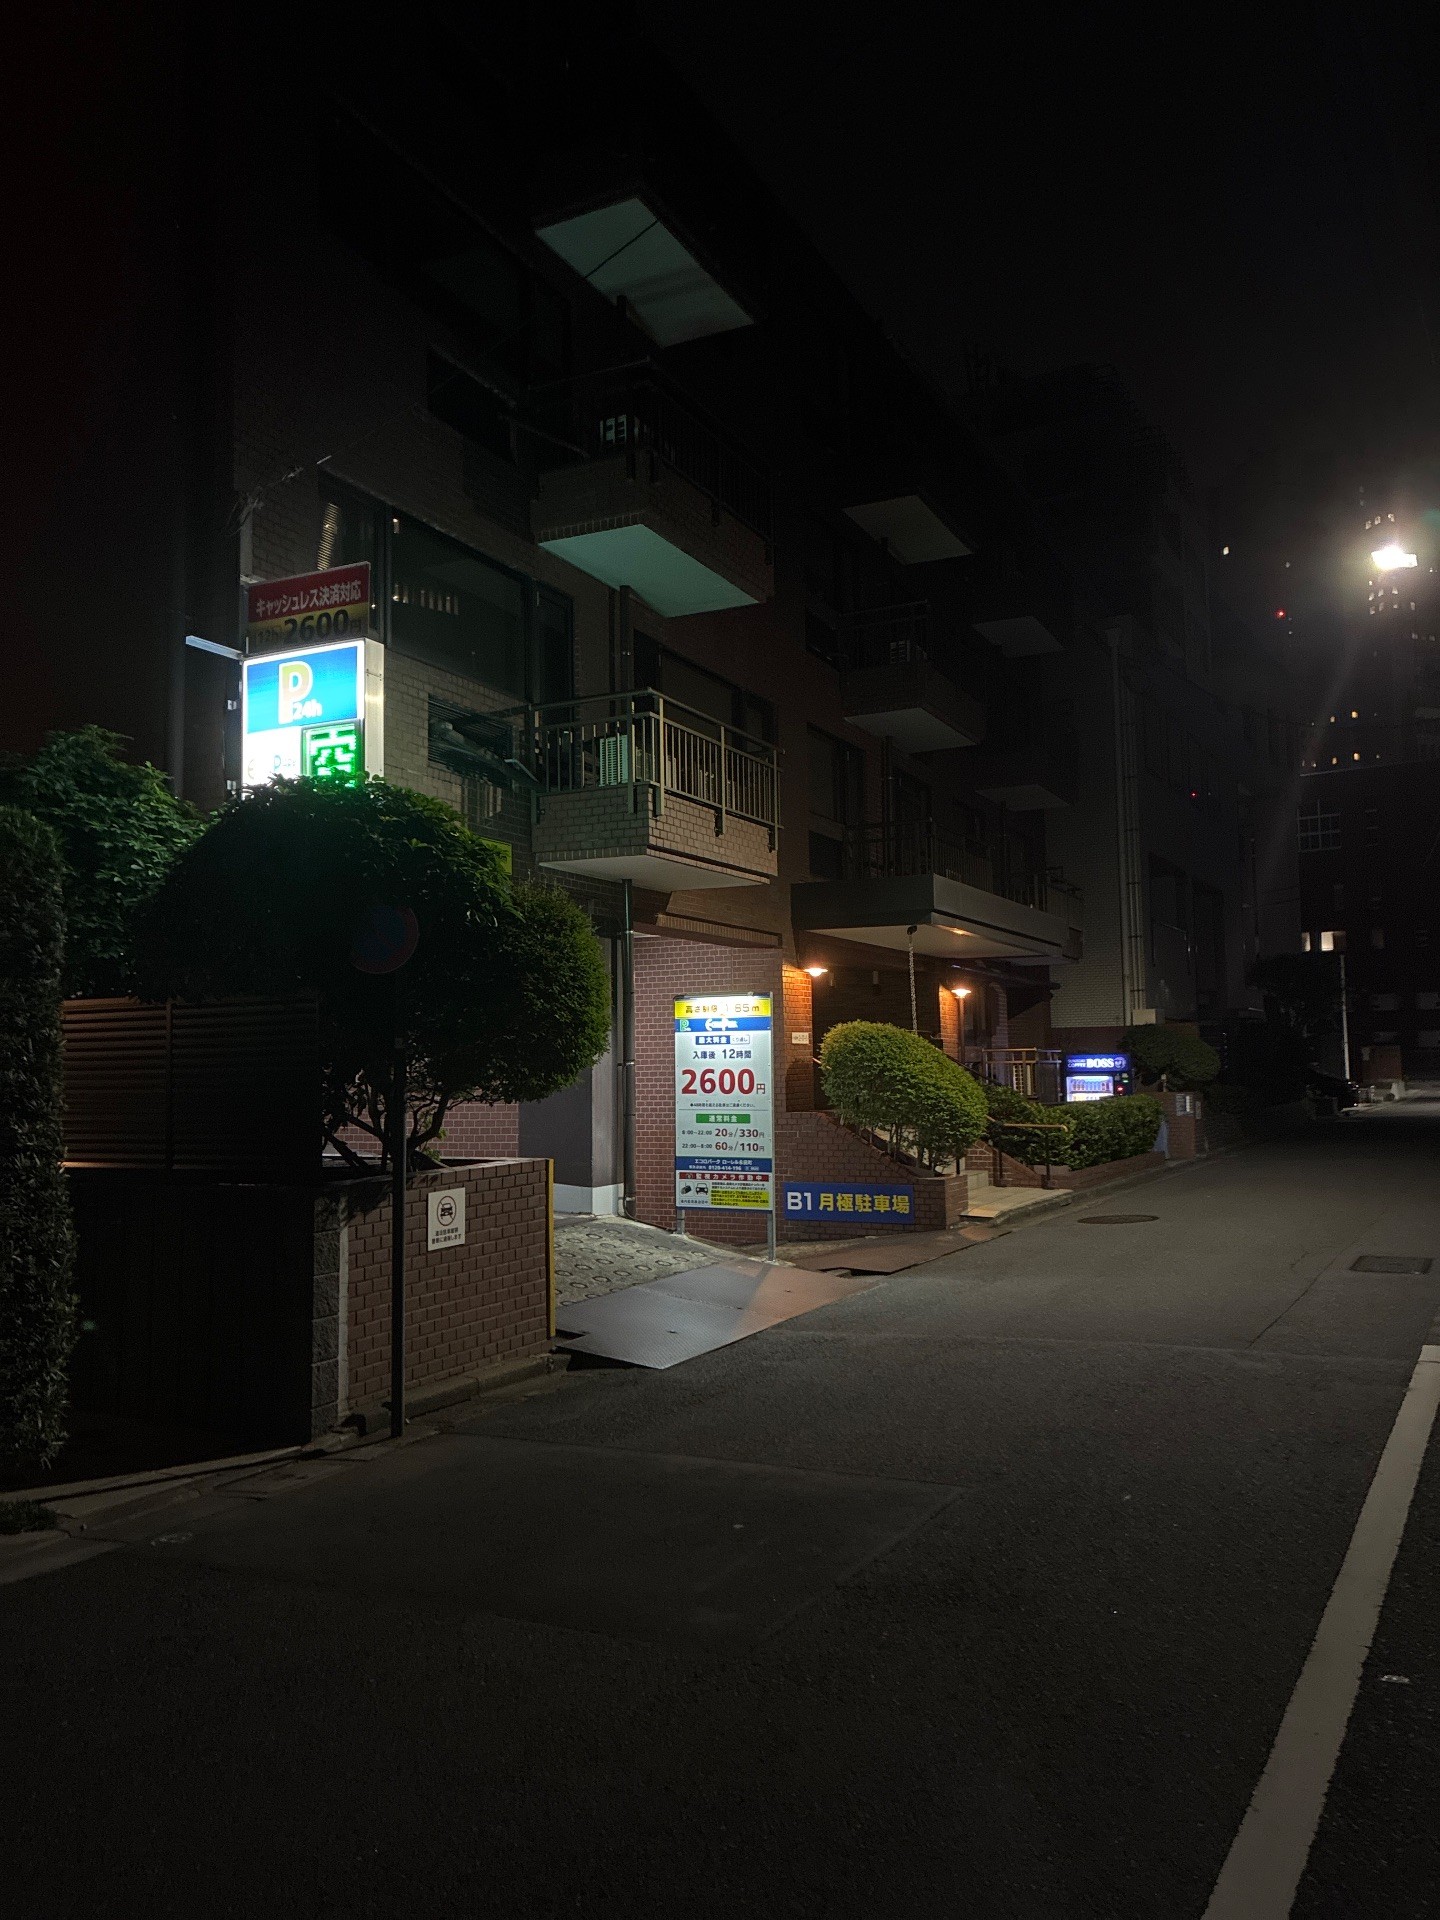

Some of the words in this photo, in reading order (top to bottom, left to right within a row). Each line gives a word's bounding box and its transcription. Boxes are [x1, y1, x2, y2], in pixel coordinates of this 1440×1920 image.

[255, 579, 362, 618] キャッシュレス決済対応
[278, 660, 313, 725] P
[692, 1050, 716, 1060] 入庫後
[722, 1048, 752, 1059] 12時間
[1086, 1058, 1114, 1068] BOSS
[681, 1068, 766, 1095] 2600円
[708, 1114, 738, 1123] 通常料金
[787, 1191, 812, 1211] B1
[818, 1192, 911, 1214] 月極駐車場
